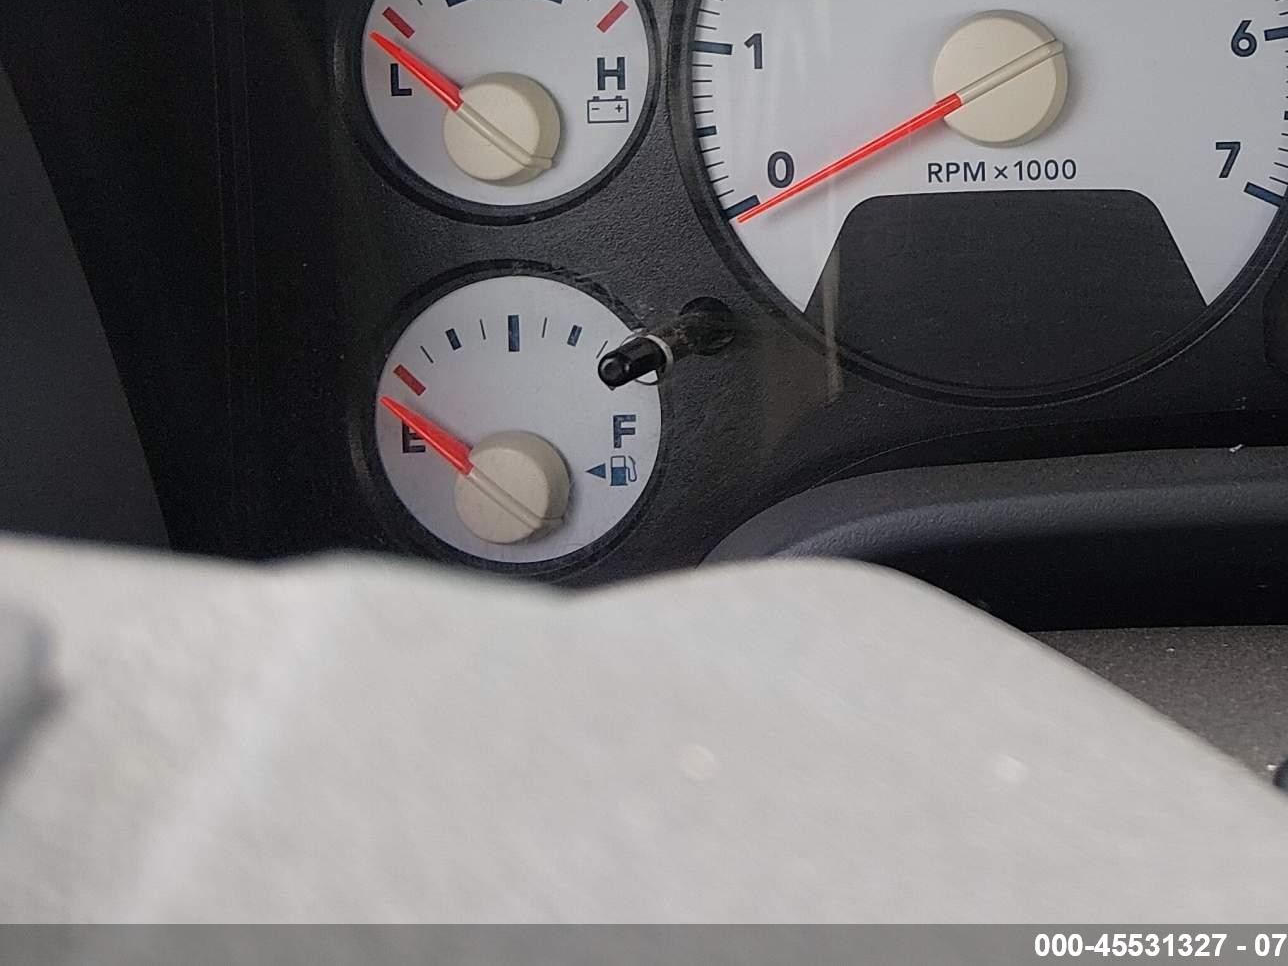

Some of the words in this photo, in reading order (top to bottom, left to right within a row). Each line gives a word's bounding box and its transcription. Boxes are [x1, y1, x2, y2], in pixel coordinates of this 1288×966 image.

[743, 32, 763, 70] 1
[1230, 19, 1258, 58] 6
[390, 63, 412, 97] L
[596, 56, 626, 91] H
[767, 150, 794, 189] 0
[927, 161, 986, 183] RPM
[1215, 141, 1241, 179] 7
[401, 416, 427, 454] E
[612, 414, 637, 449] F
